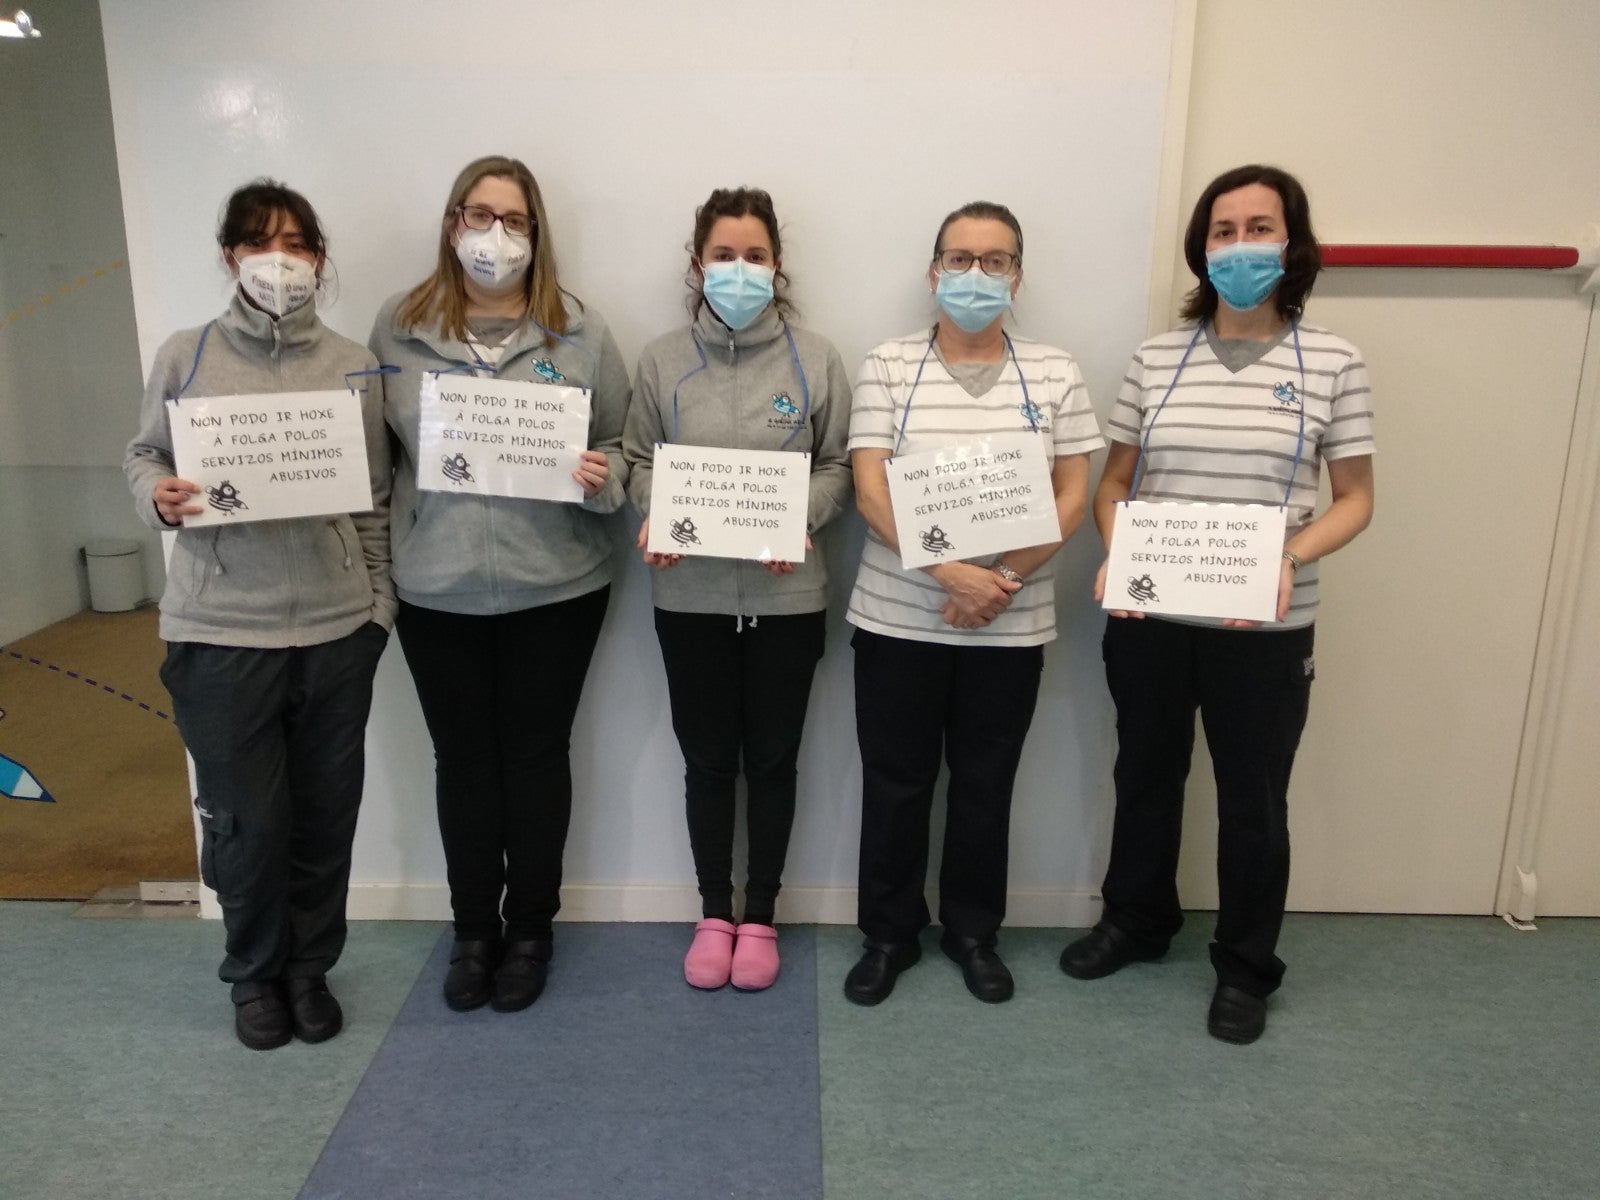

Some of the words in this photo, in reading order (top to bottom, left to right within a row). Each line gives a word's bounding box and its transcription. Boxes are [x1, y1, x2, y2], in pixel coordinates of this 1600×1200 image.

[440, 392, 467, 403] NON
[474, 394, 506, 407] PODO
[515, 399, 528, 408] IR
[535, 401, 565, 413] HOXE
[191, 416, 222, 427] NON
[230, 413, 267, 426] PODO
[277, 411, 292, 422] IR
[300, 409, 334, 421] HOXE
[472, 413, 510, 426] FOLGA
[518, 417, 555, 430] POLOS
[232, 433, 276, 445] FOLGA
[285, 429, 327, 442] POLOS
[443, 429, 504, 444] SERVIZOS
[511, 434, 566, 450] MÍNIMOS
[201, 453, 273, 468] SERVIZOS
[281, 448, 343, 462] MÍNIMOS
[498, 453, 557, 467] ABUSIVOS
[904, 469, 929, 481] NON
[935, 461, 966, 475] PODO
[974, 456, 987, 467] IR
[993, 450, 1022, 463] HOXE
[269, 468, 336, 483] ABUSIVOS
[670, 461, 695, 471] NON
[702, 462, 732, 473] PODO
[739, 465, 751, 474] IR
[758, 466, 787, 476] HOXE
[699, 480, 735, 491] FOLGA
[743, 483, 778, 493] POLOS
[938, 478, 975, 493] FOLGA
[981, 469, 1017, 484] POLOS
[672, 495, 730, 508] SERVIZOS
[736, 498, 787, 511] MÍNIMOS
[915, 496, 973, 516] SERVIZOS
[971, 504, 1028, 523] ABUSIVOS
[723, 516, 779, 528] ABUSIVOS
[1132, 518, 1158, 528] NON
[1165, 520, 1198, 530] PODO
[1205, 521, 1219, 530] IR
[1226, 521, 1258, 531] HOXE
[1161, 537, 1200, 546] FOLGA
[1208, 538, 1247, 548] POLOS
[1131, 553, 1193, 564] SERVIZOS
[1200, 555, 1257, 567] MÍNIMOS
[1184, 573, 1247, 584] ABUSIVOS
